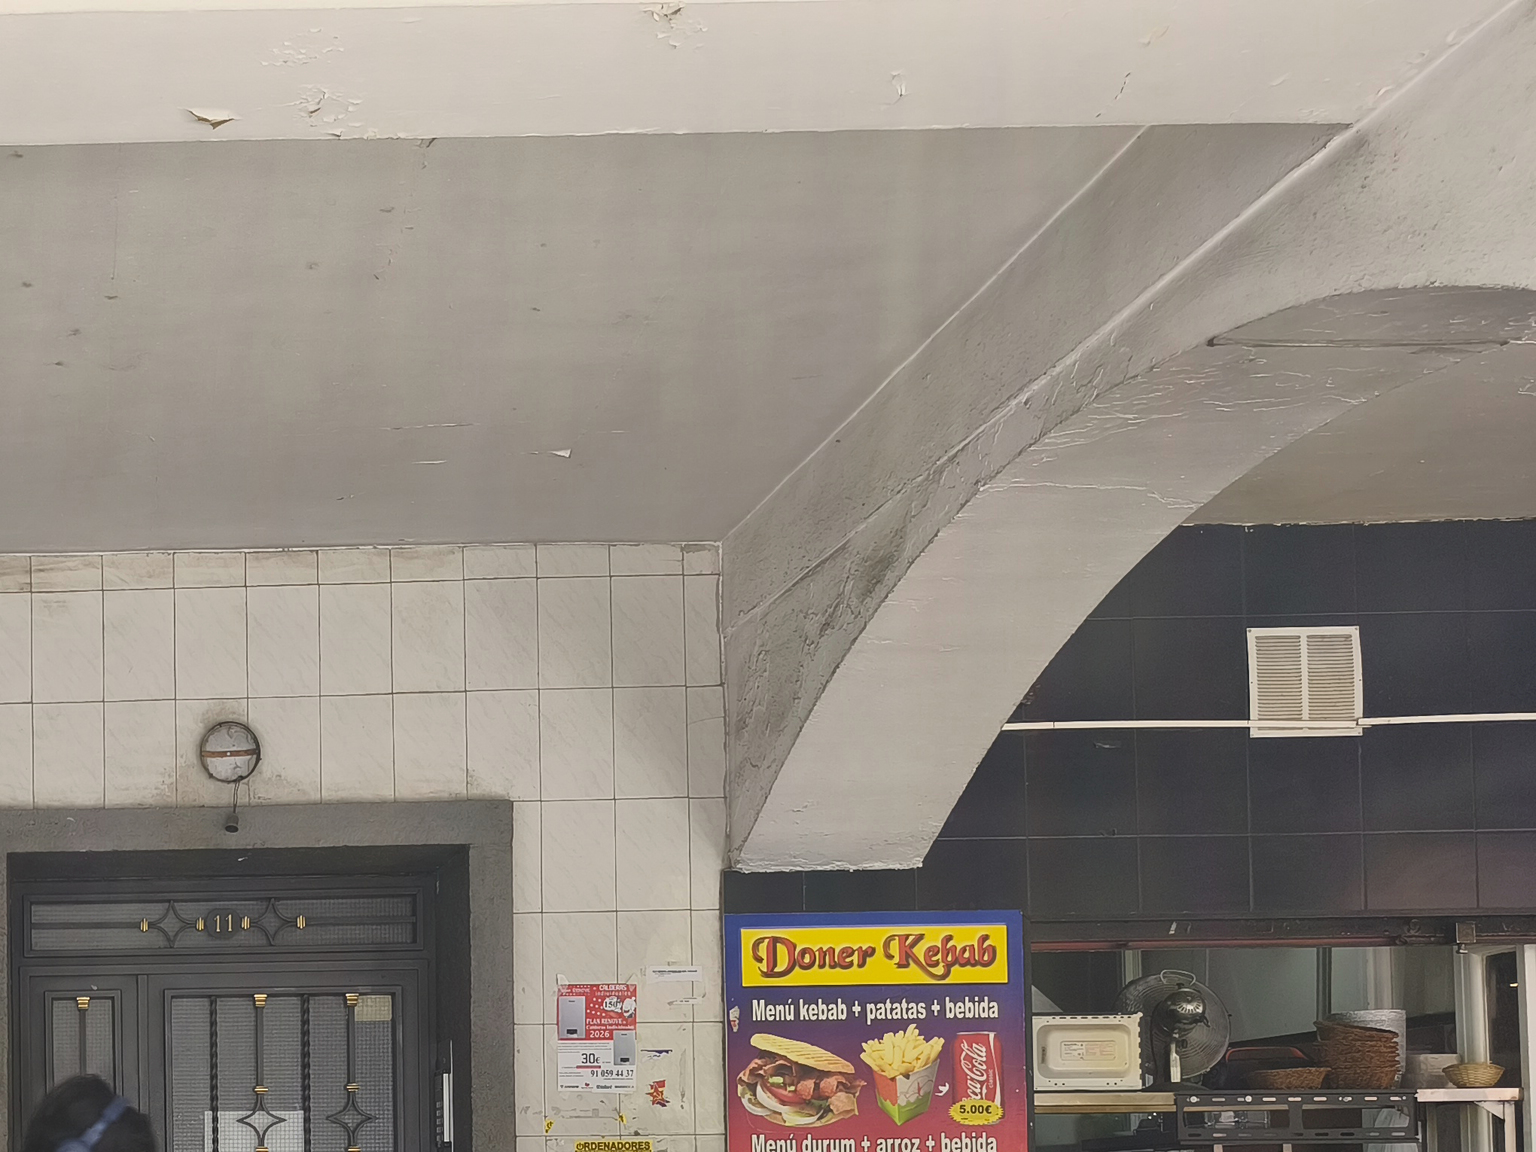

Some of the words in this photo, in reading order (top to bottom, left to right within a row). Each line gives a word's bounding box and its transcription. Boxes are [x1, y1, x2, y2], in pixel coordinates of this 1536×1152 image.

[213, 914, 234, 933] 11
[751, 935, 876, 979] Doner
[882, 933, 998, 981] Kebab
[752, 999, 795, 1021] Menú
[799, 998, 847, 1021] kebab
[866, 999, 927, 1025] patatas
[945, 996, 999, 1019] bebida
[589, 1030, 610, 1038] 2026
[590, 1069, 599, 1078] 91
[615, 1069, 624, 1078] 44
[625, 1069, 634, 1078] 37
[959, 1104, 992, 1115] 5.00€
